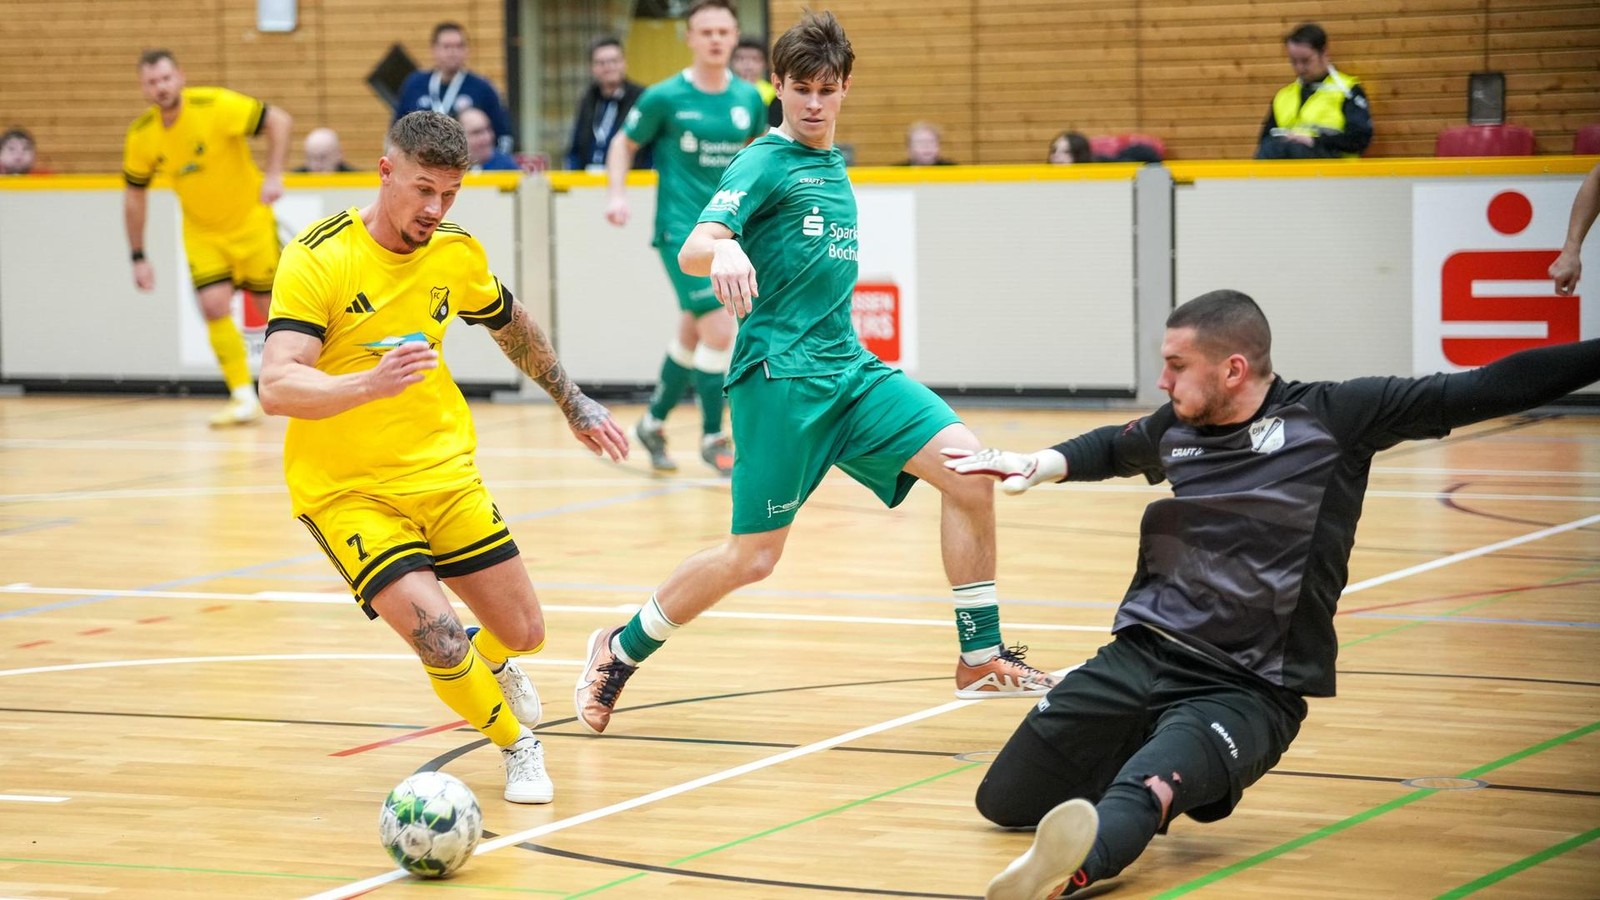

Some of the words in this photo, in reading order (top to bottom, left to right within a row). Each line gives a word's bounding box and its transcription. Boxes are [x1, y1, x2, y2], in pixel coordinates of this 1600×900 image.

[1171, 447, 1197, 457] CRAFT
[346, 533, 370, 562] 7
[1210, 722, 1236, 749] CRAFT
